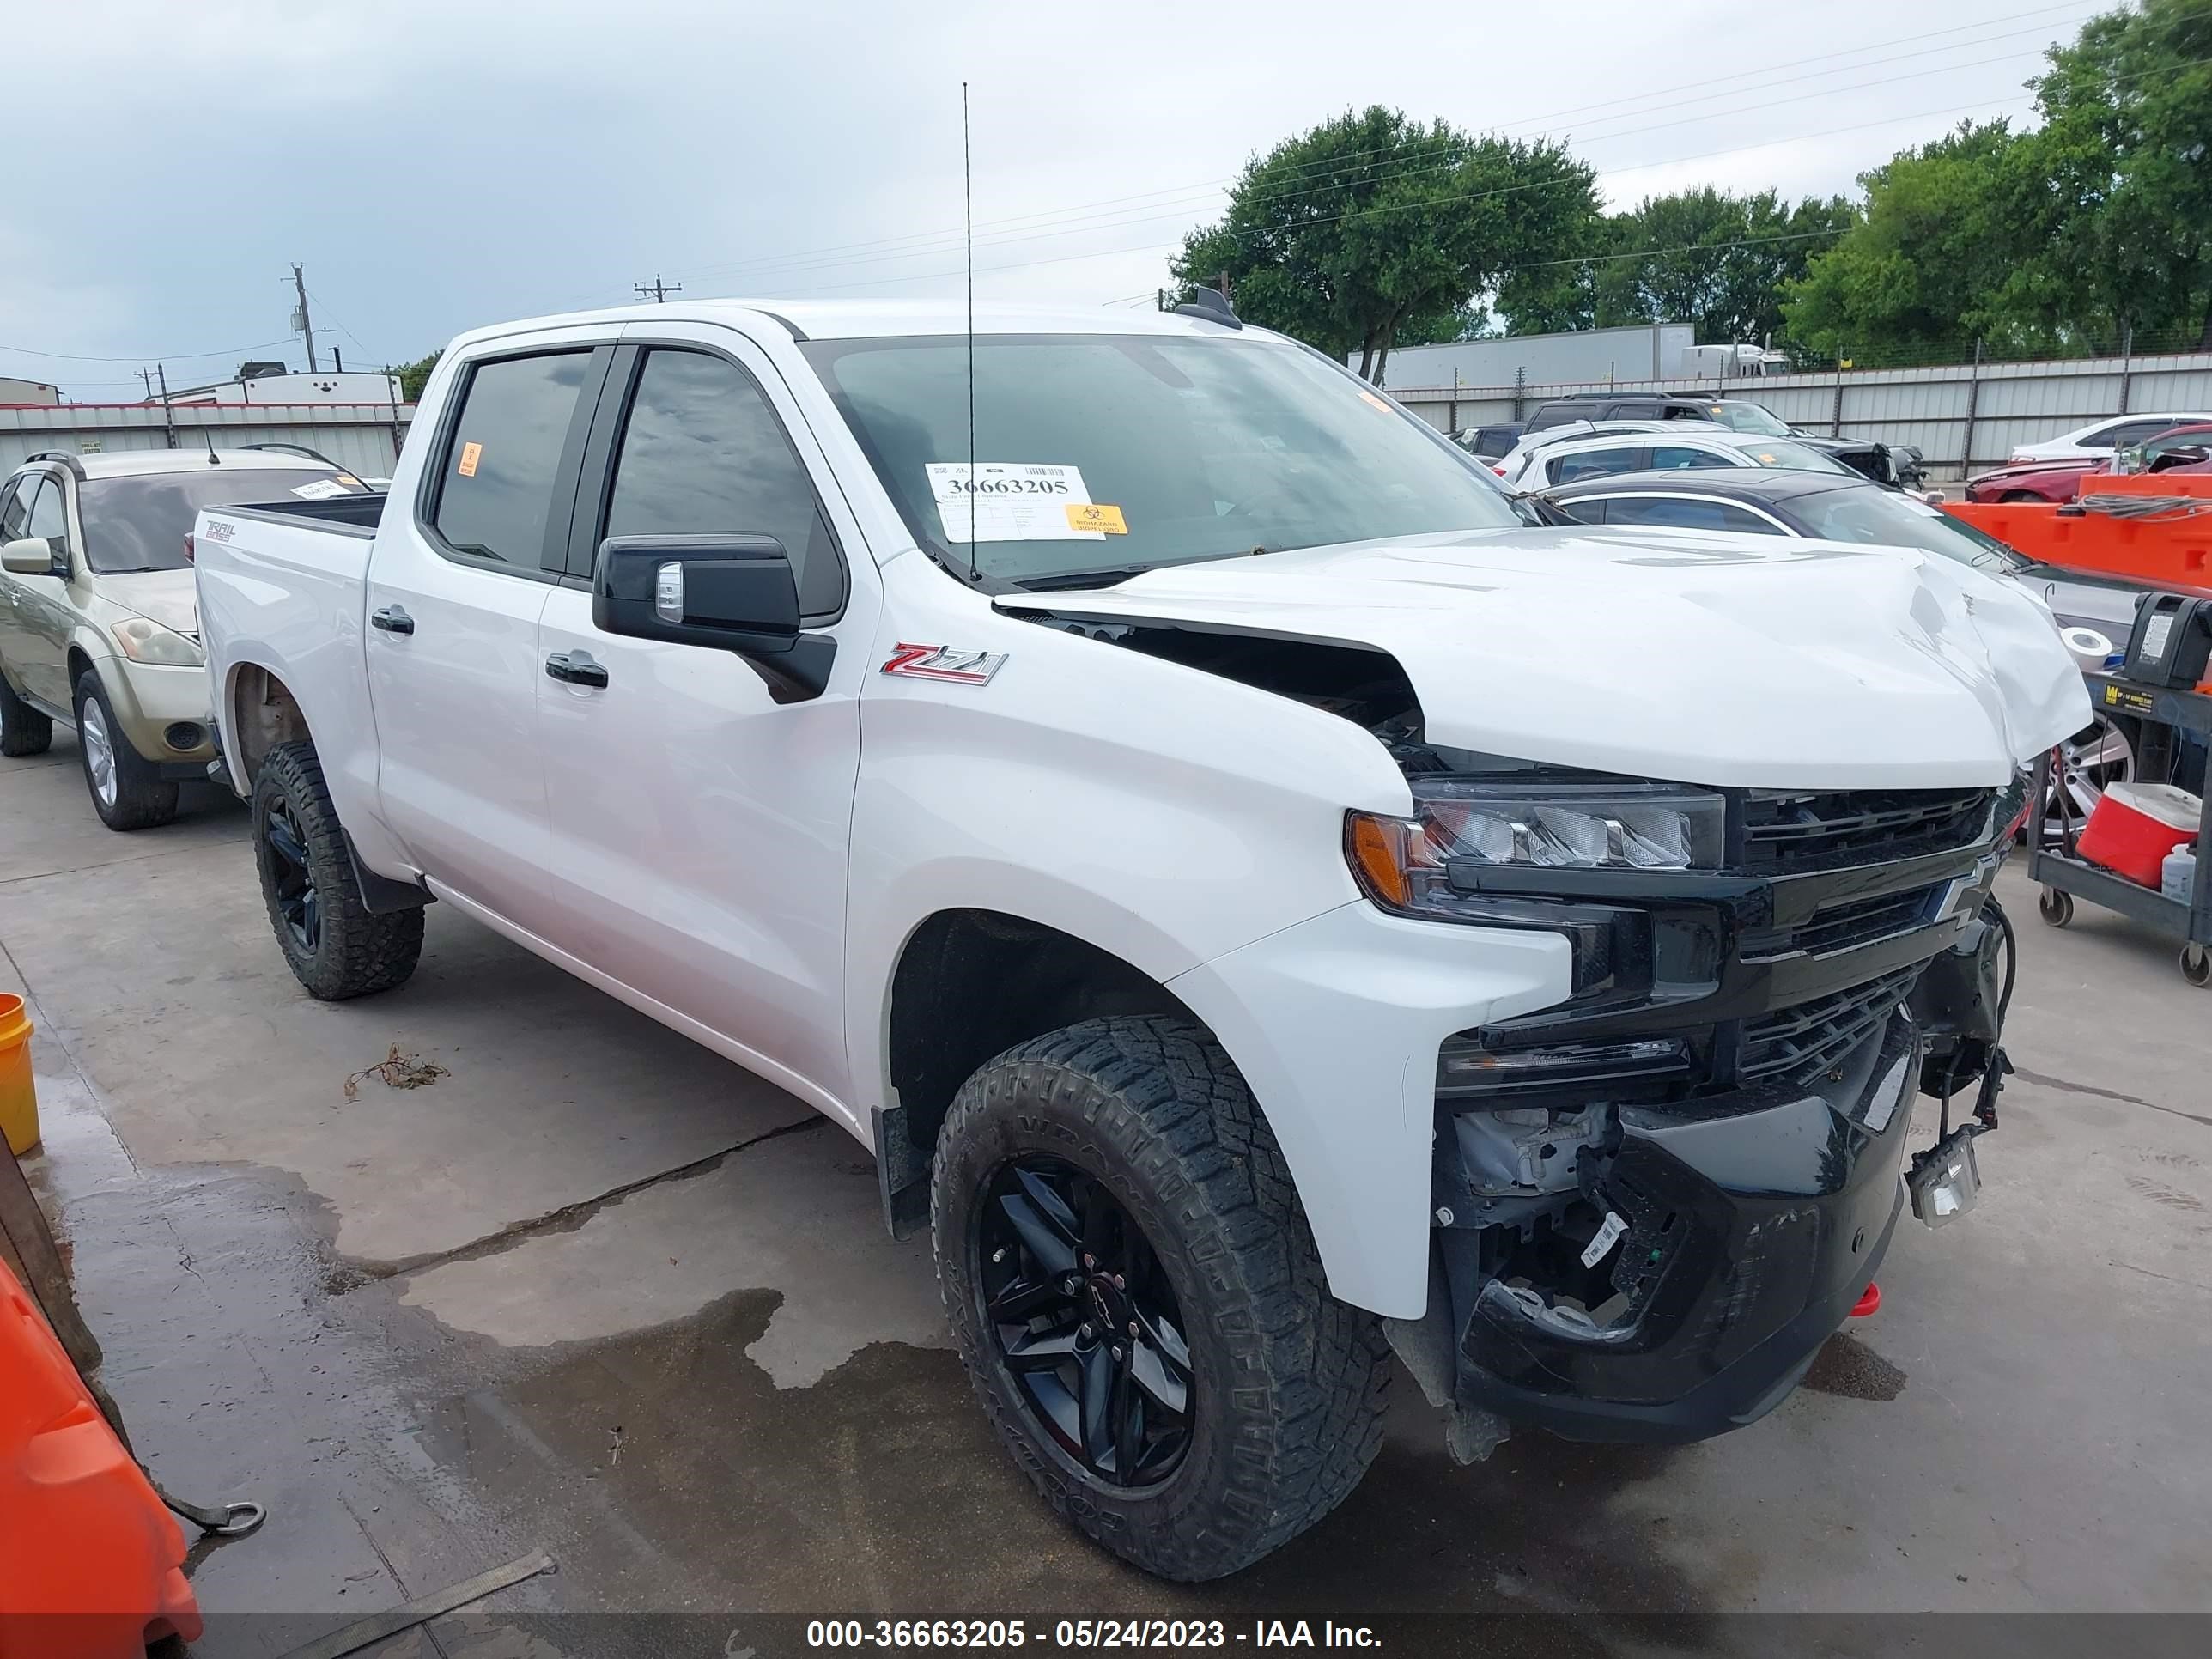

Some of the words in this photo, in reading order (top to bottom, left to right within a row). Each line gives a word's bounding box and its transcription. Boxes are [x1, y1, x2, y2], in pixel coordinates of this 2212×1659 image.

[947, 479, 1069, 495] 36663205
[206, 530, 231, 542] BOSS
[207, 520, 236, 536] TRAIL
[879, 641, 1010, 687] Z71
